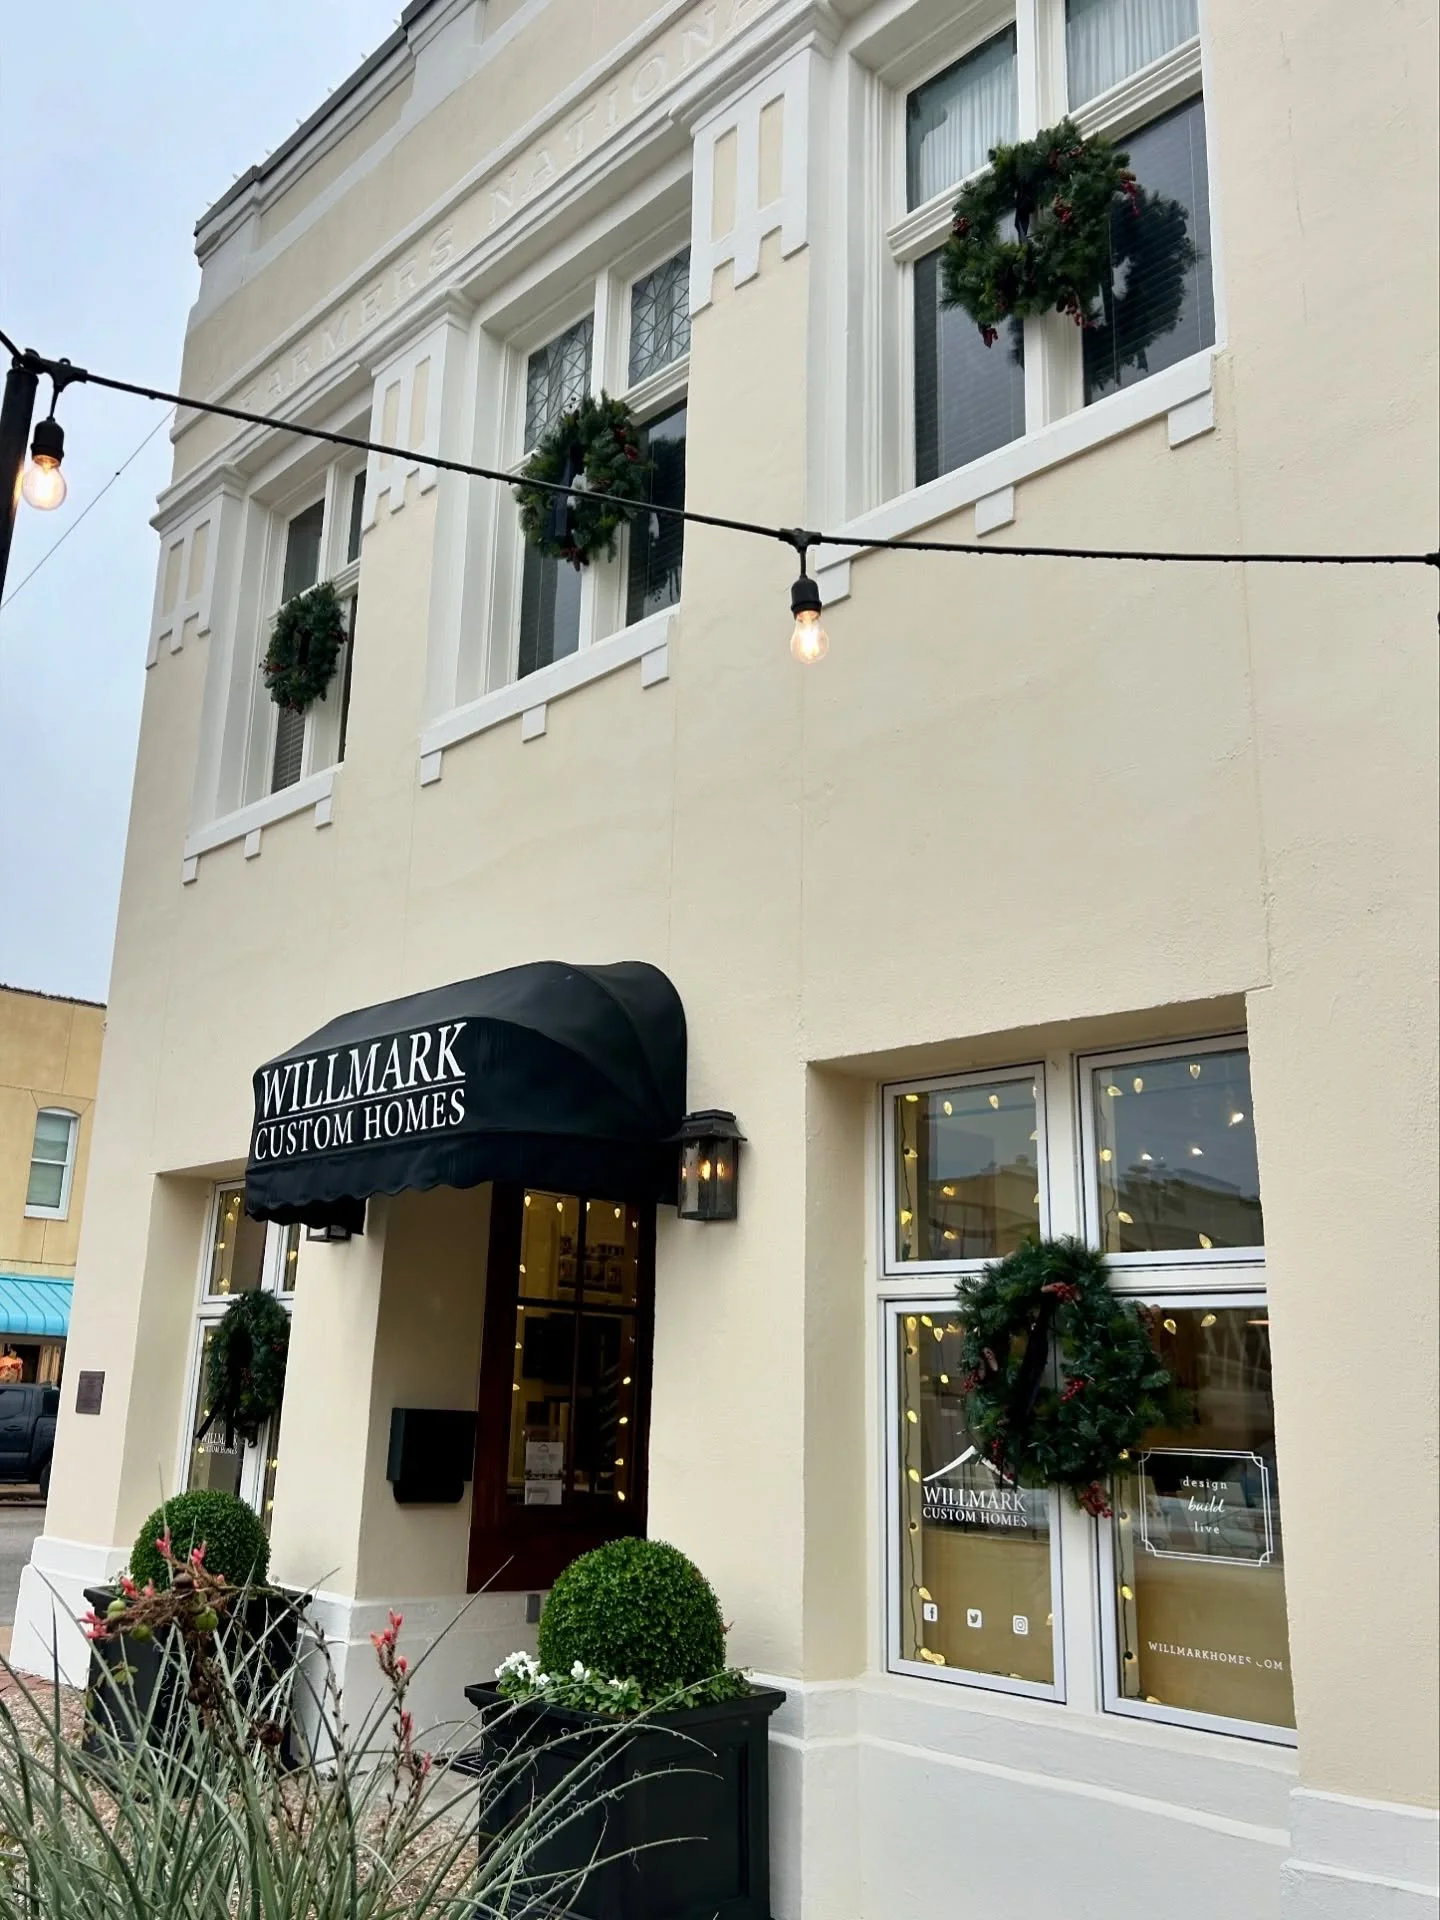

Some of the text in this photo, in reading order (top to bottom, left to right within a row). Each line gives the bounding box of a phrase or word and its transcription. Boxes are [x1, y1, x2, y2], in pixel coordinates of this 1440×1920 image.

[262, 1022, 467, 1118] WILLMARK
[255, 1088, 465, 1160] CUSTOM HOMES
[201, 1432, 238, 1447] WILLMK
[1182, 1475, 1228, 1491] design
[923, 1486, 1026, 1512] WILLMARK
[1187, 1495, 1225, 1513] build
[922, 1506, 1028, 1528] CUSTOM HOMES
[1194, 1520, 1220, 1534] live
[1148, 1640, 1284, 1671] WILLMARKHOMESOM
